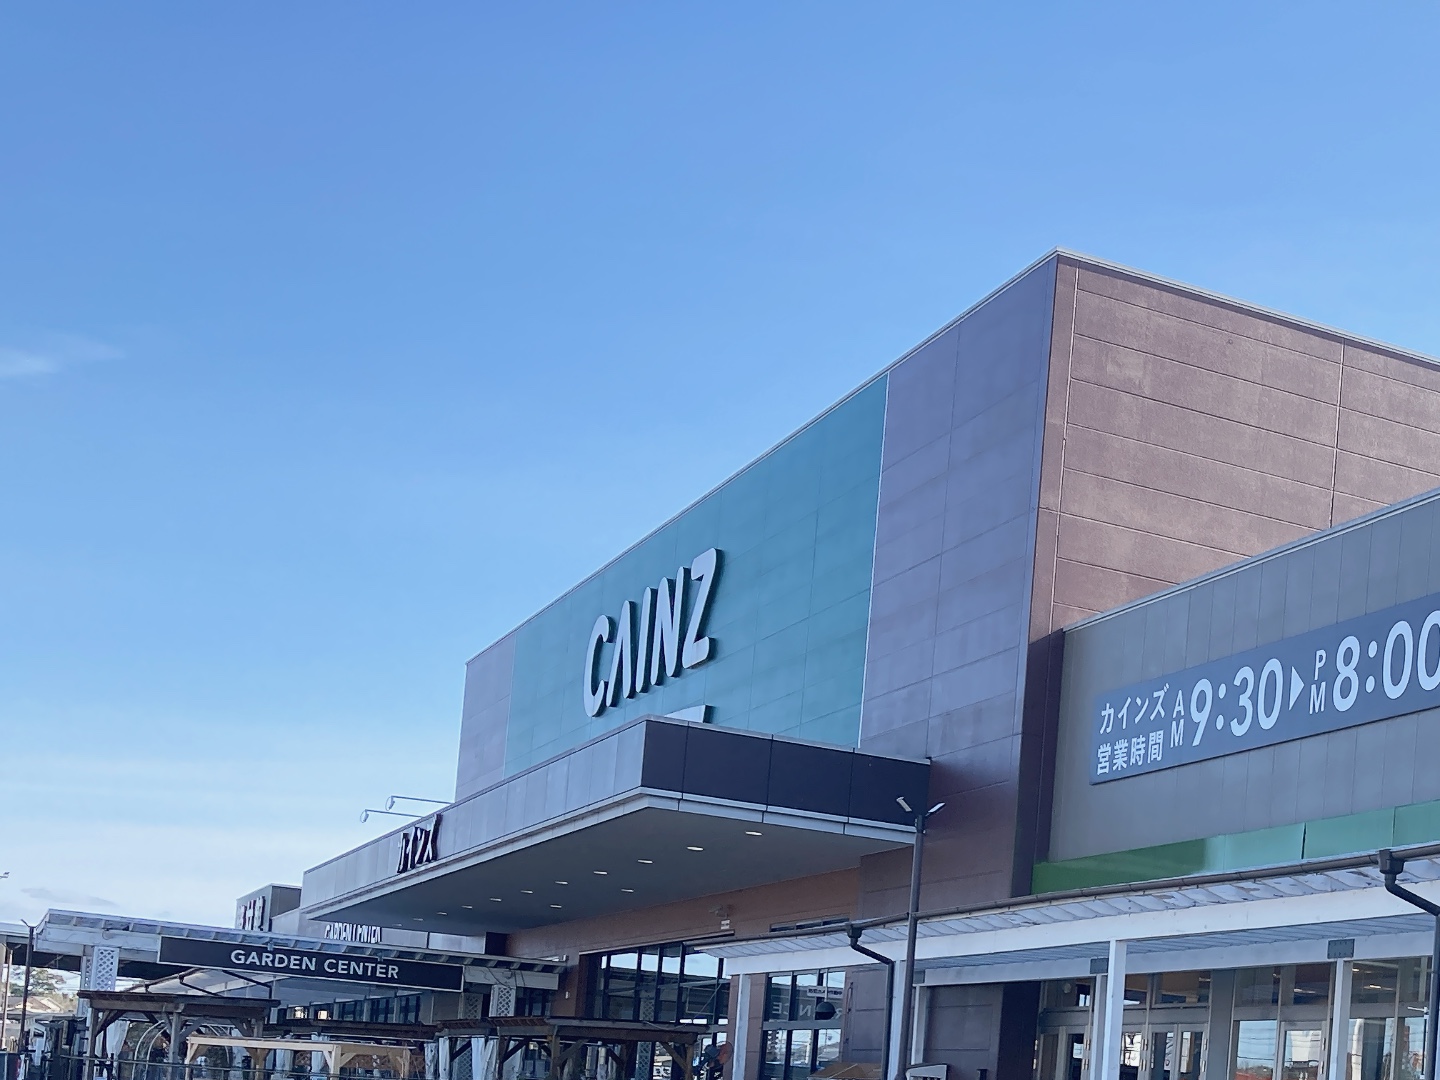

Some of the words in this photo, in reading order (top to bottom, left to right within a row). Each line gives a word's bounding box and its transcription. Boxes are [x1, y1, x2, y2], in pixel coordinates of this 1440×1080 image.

[584, 547, 722, 717] CAINZ
[1098, 683, 1170, 736] カインズ
[1170, 689, 1185, 748] AM
[1190, 658, 1284, 747] 9:30
[1309, 649, 1327, 715] PM
[1096, 730, 1164, 776] 営業時間
[230, 949, 317, 971] GARDEN
[323, 958, 399, 979] CENTER
